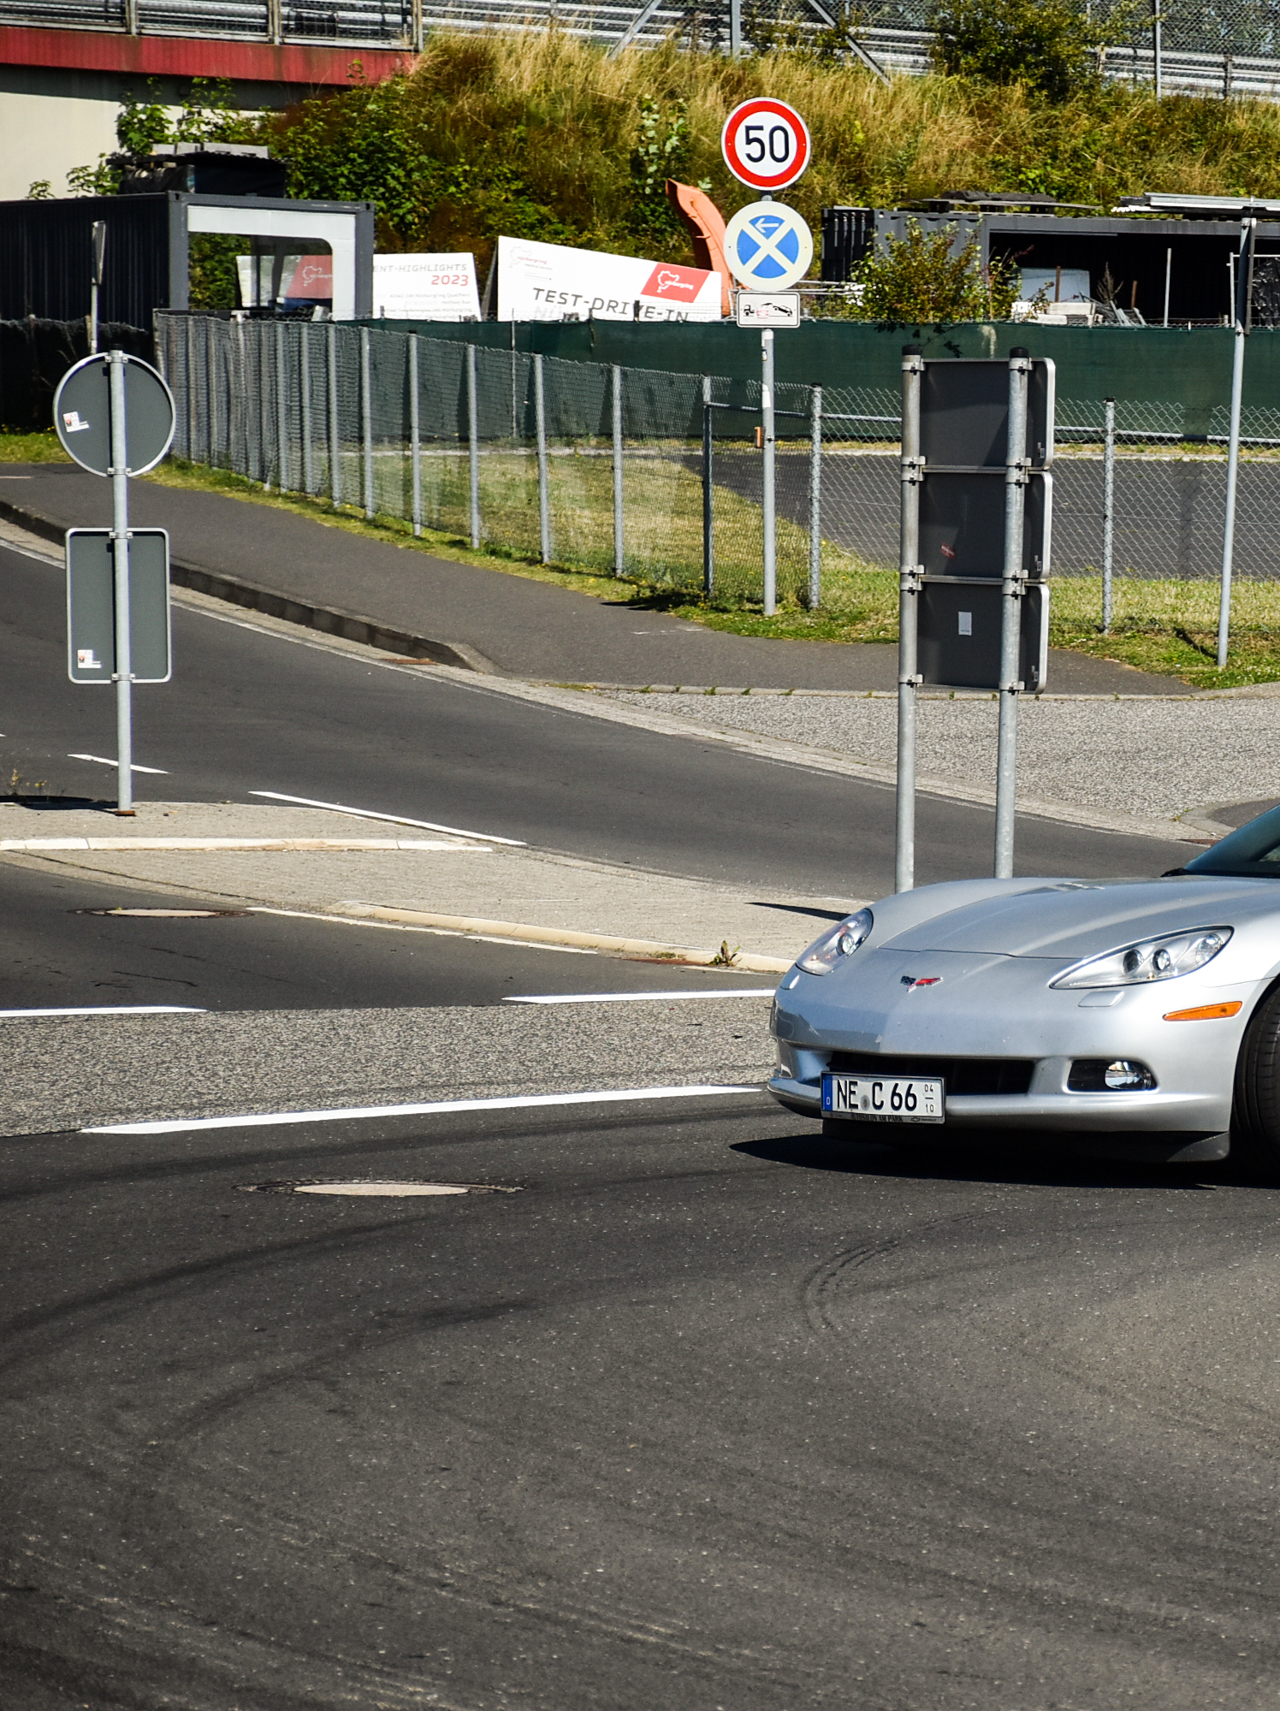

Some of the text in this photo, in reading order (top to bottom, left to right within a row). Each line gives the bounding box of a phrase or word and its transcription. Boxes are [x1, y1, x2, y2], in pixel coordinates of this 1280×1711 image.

[744, 125, 790, 163] 50
[431, 274, 469, 286] 2023
[924, 1084, 934, 1093] 04
[825, 1097, 831, 1105] D
[838, 1080, 918, 1112] NE C 66
[925, 1104, 935, 1113] 10
